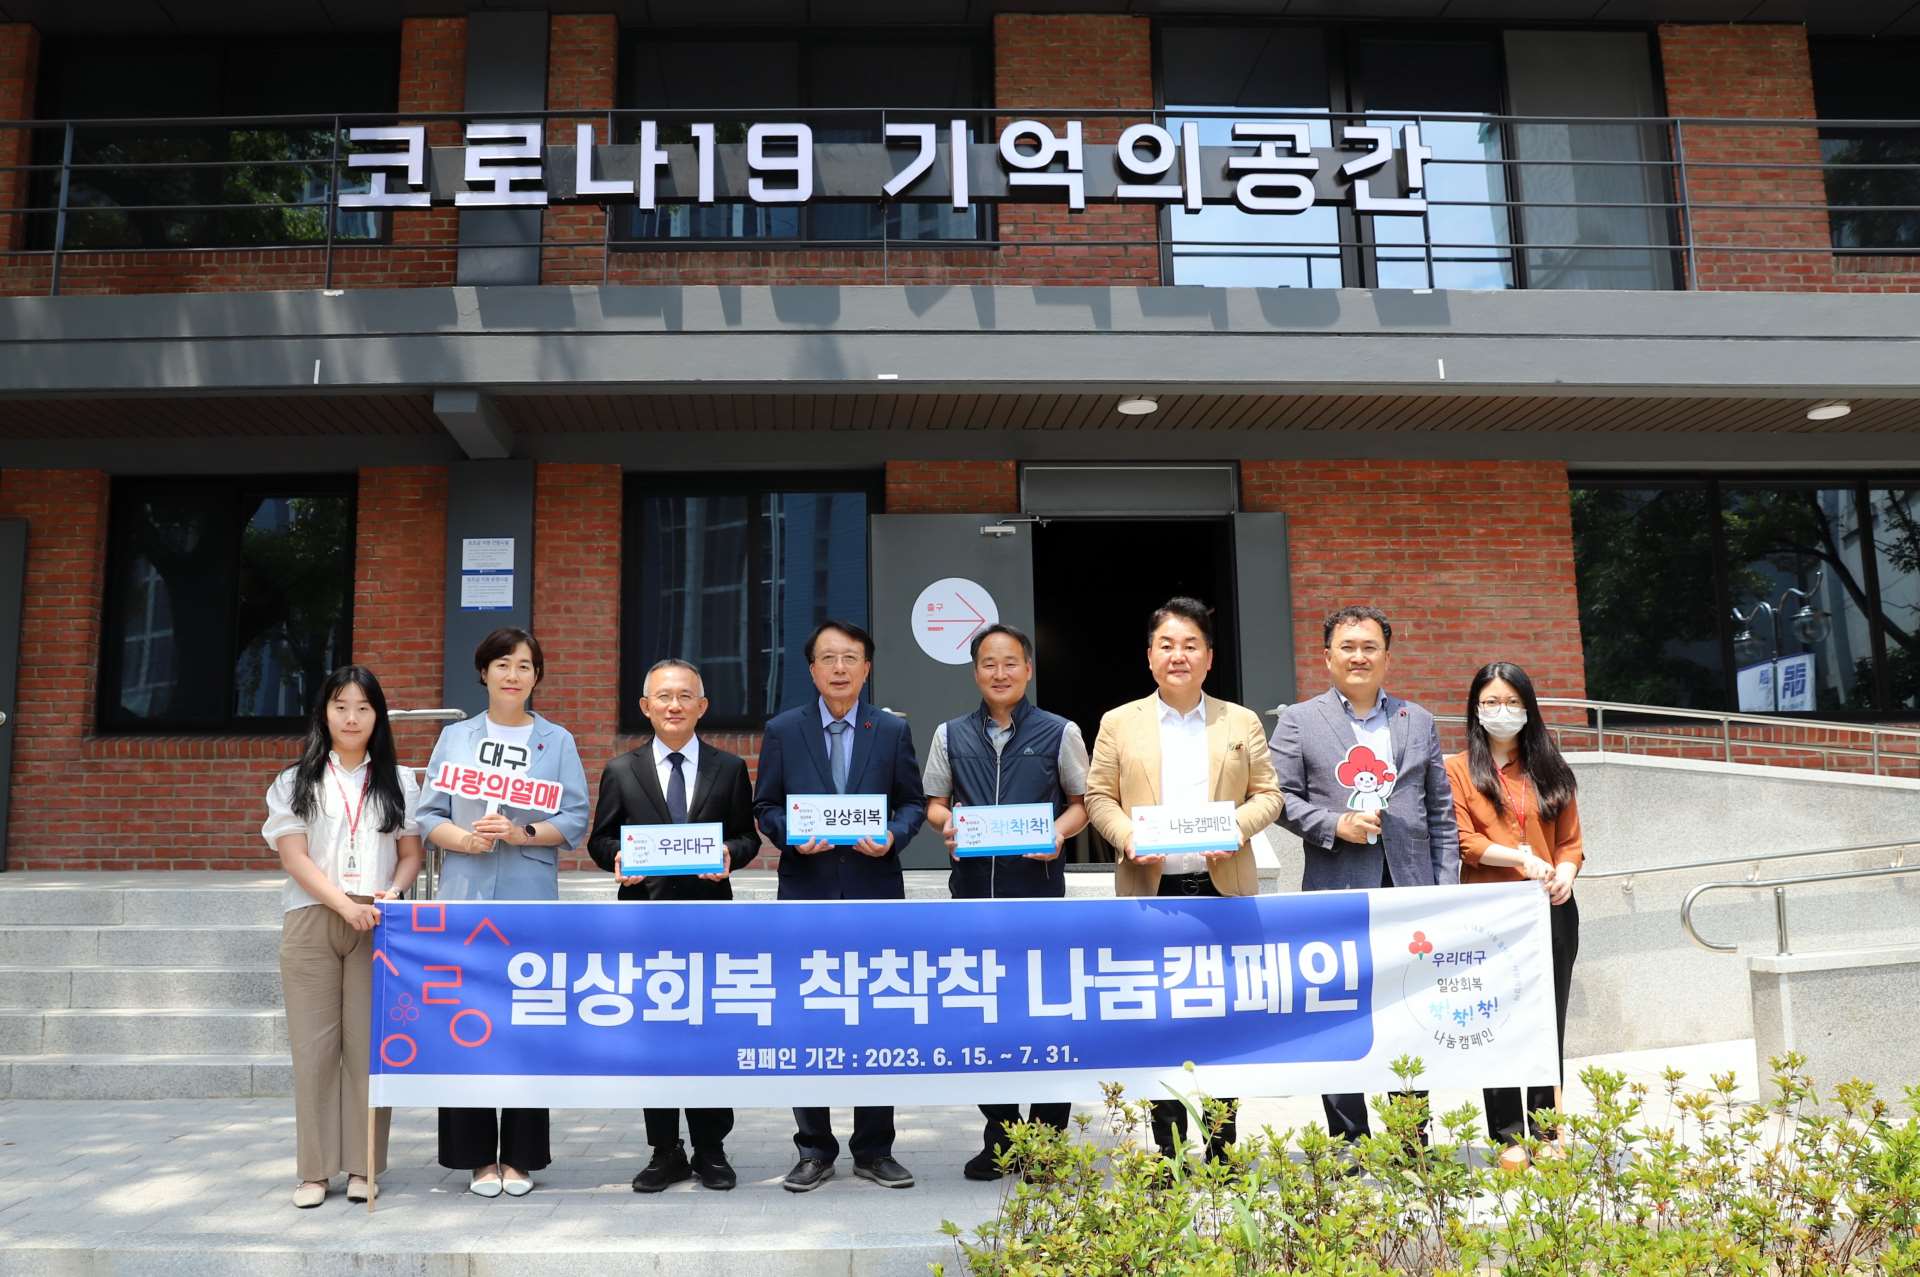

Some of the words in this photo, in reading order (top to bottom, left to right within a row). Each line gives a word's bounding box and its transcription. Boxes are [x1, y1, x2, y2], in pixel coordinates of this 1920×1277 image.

[338, 121, 814, 209] 코로나19
[479, 741, 528, 771] 대구
[434, 765, 560, 810] 사랑의열매
[823, 808, 882, 826] 일상회복
[1170, 815, 1231, 834] 나눔캠페인
[658, 837, 716, 855] 우리대구
[1432, 949, 1487, 968] 우리대구
[507, 950, 776, 1027] 일상회복
[799, 947, 1006, 1026] 착착착
[1027, 940, 1359, 1022] 나눔캠페인
[1437, 976, 1483, 993] 일상회복
[1434, 1026, 1495, 1050] 나눔캠페인
[737, 1047, 797, 1070] 캠페인
[805, 1047, 845, 1069] 기간
[865, 1047, 926, 1068] 2023.
[933, 1047, 953, 1066] 6.
[961, 1047, 993, 1066] 15.
[1020, 1045, 1039, 1065] 7.
[1046, 1045, 1080, 1064] 31.
